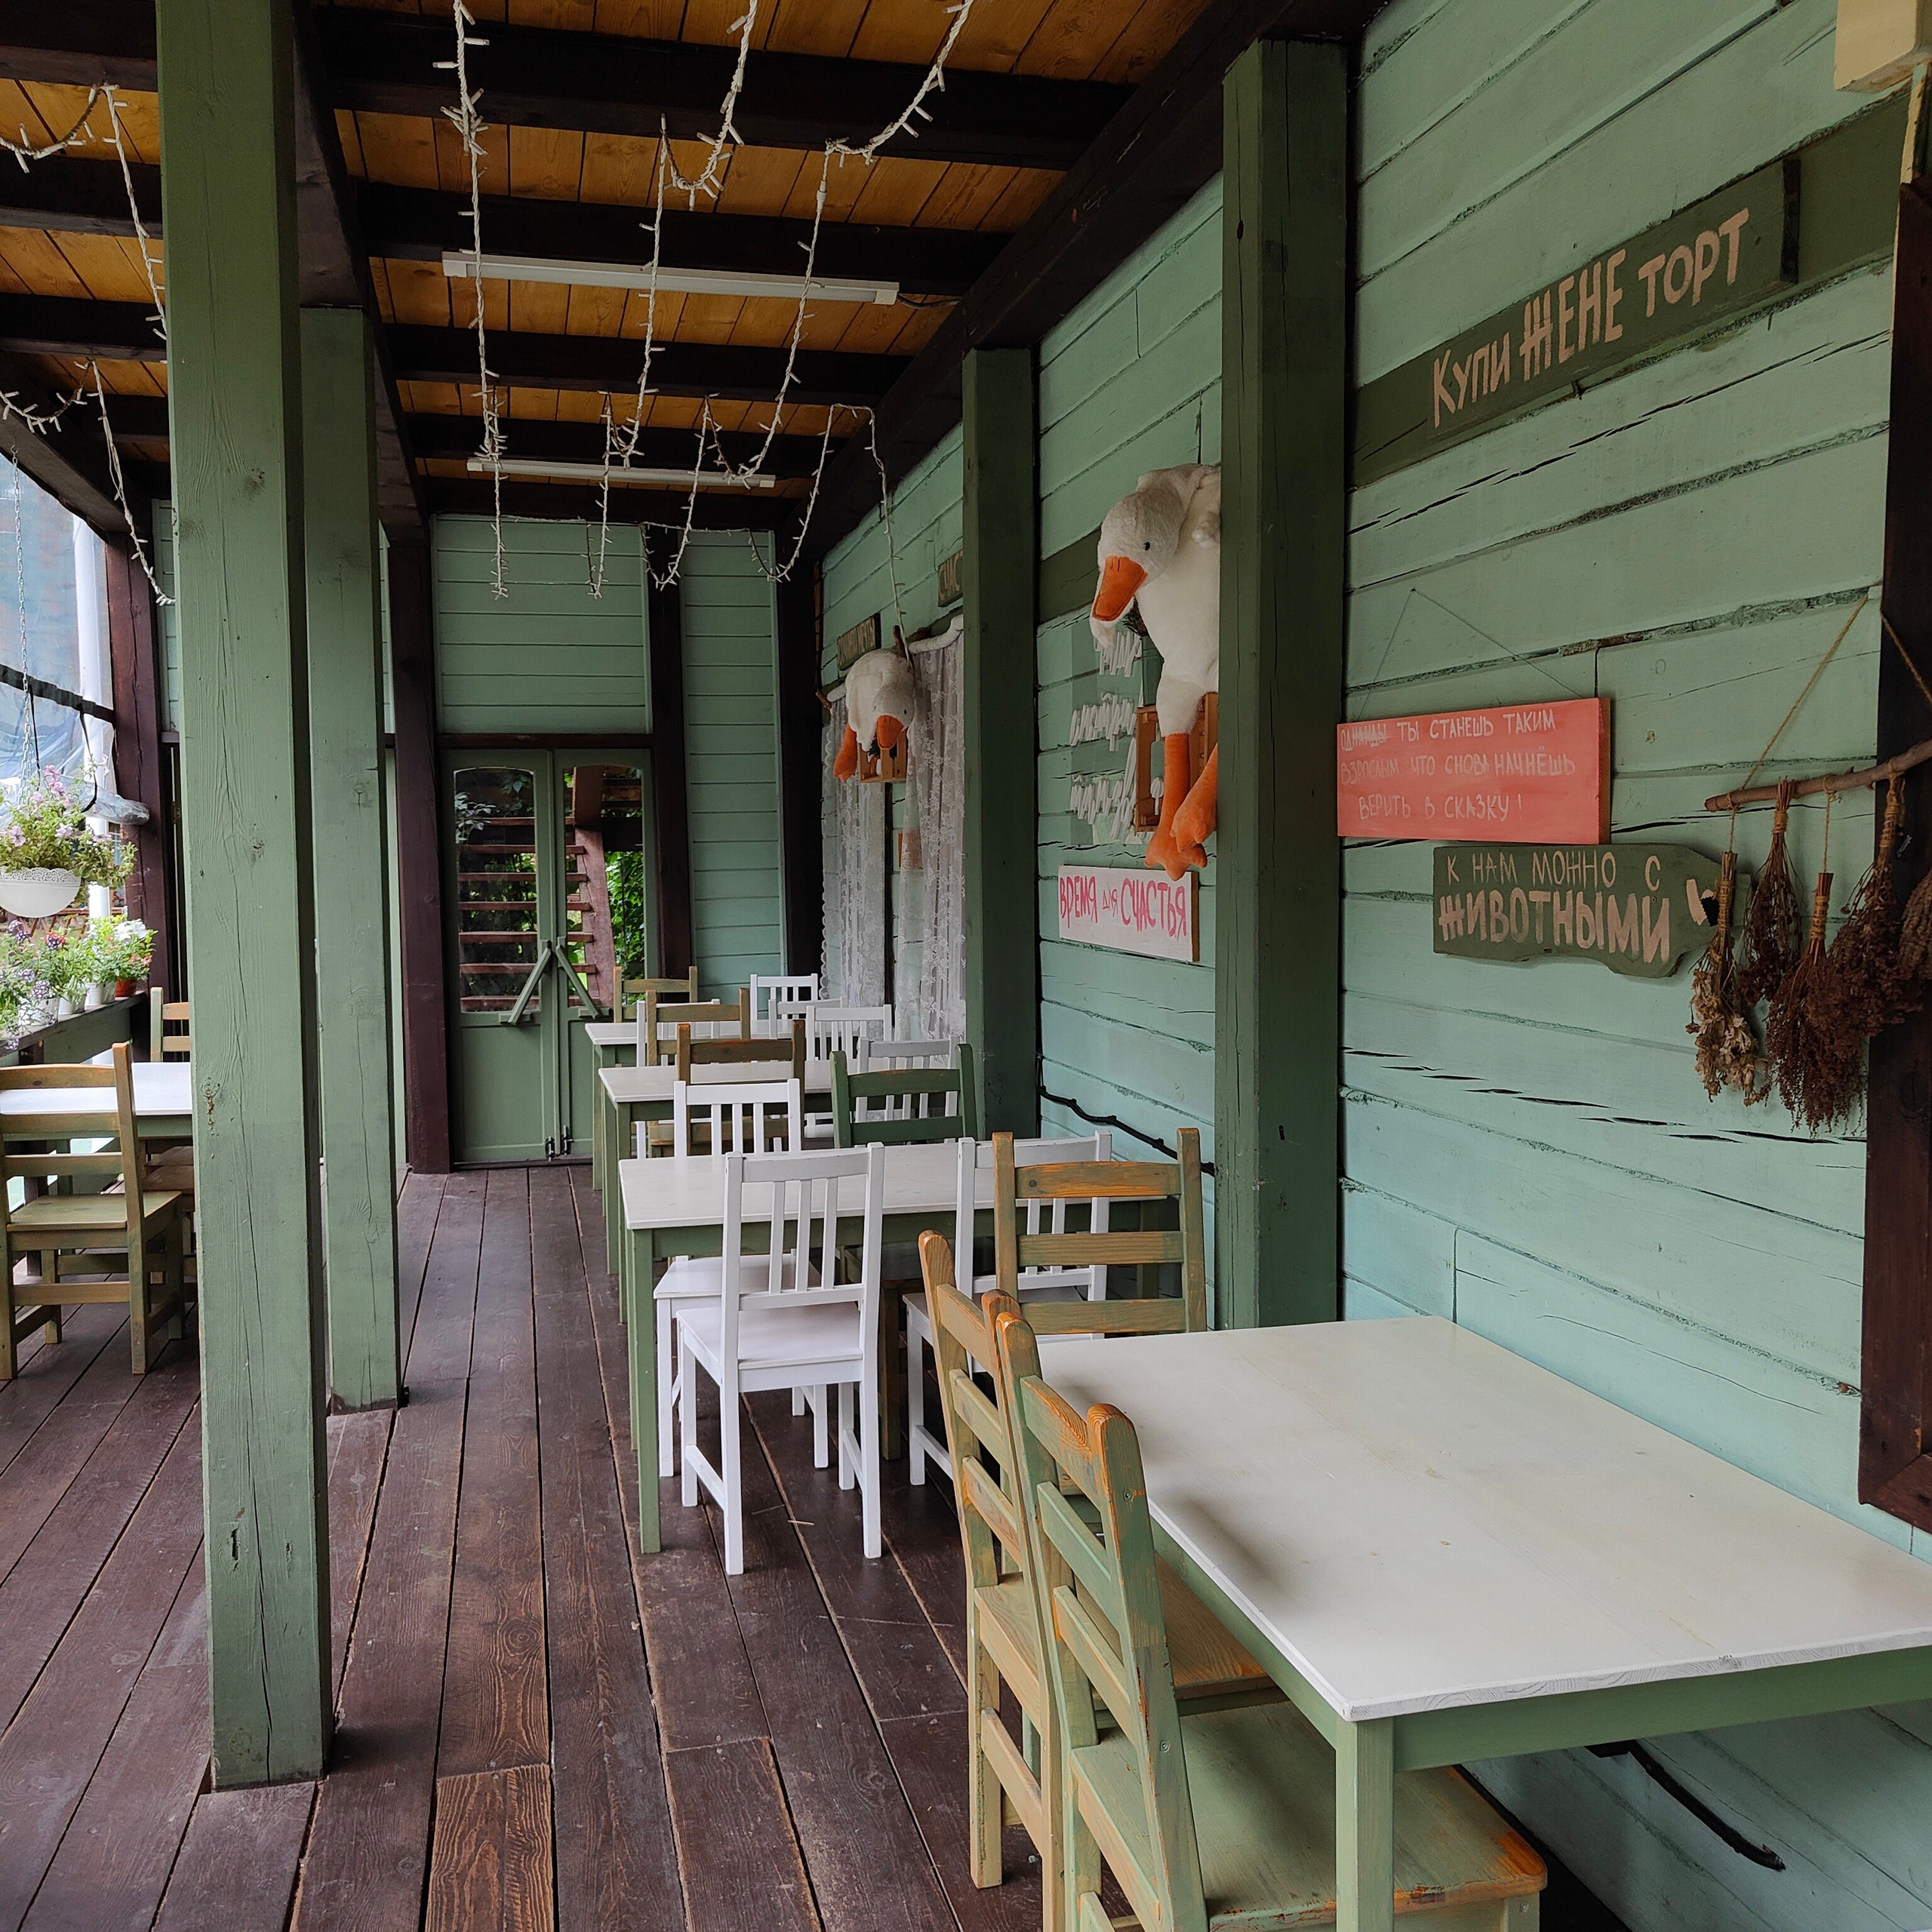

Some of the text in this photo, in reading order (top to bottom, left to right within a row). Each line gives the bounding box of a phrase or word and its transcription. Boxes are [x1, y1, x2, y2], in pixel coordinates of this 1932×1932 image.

[1434, 208, 1749, 428] КУПИ ЖЕНЕ ТОРТ
[1396, 721, 1420, 743] ТЫ
[1429, 716, 1494, 740] СТАНЕШЬ
[1503, 709, 1556, 735] ТАКИМ
[1340, 746, 1576, 786] ВЗРОСЛЫМ ЧТО СНОВА НАЧНЁШЬ
[1358, 793, 1411, 821] ВЕРИТЬ
[1425, 796, 1435, 821] В
[1447, 849, 1661, 892] К НАМ МОЖНО С
[1060, 875, 1098, 929] ВРЕМЯ
[1121, 877, 1188, 943] СЧАСТЬЯ
[1438, 887, 1671, 964] ЖИВОТНЫМИ
